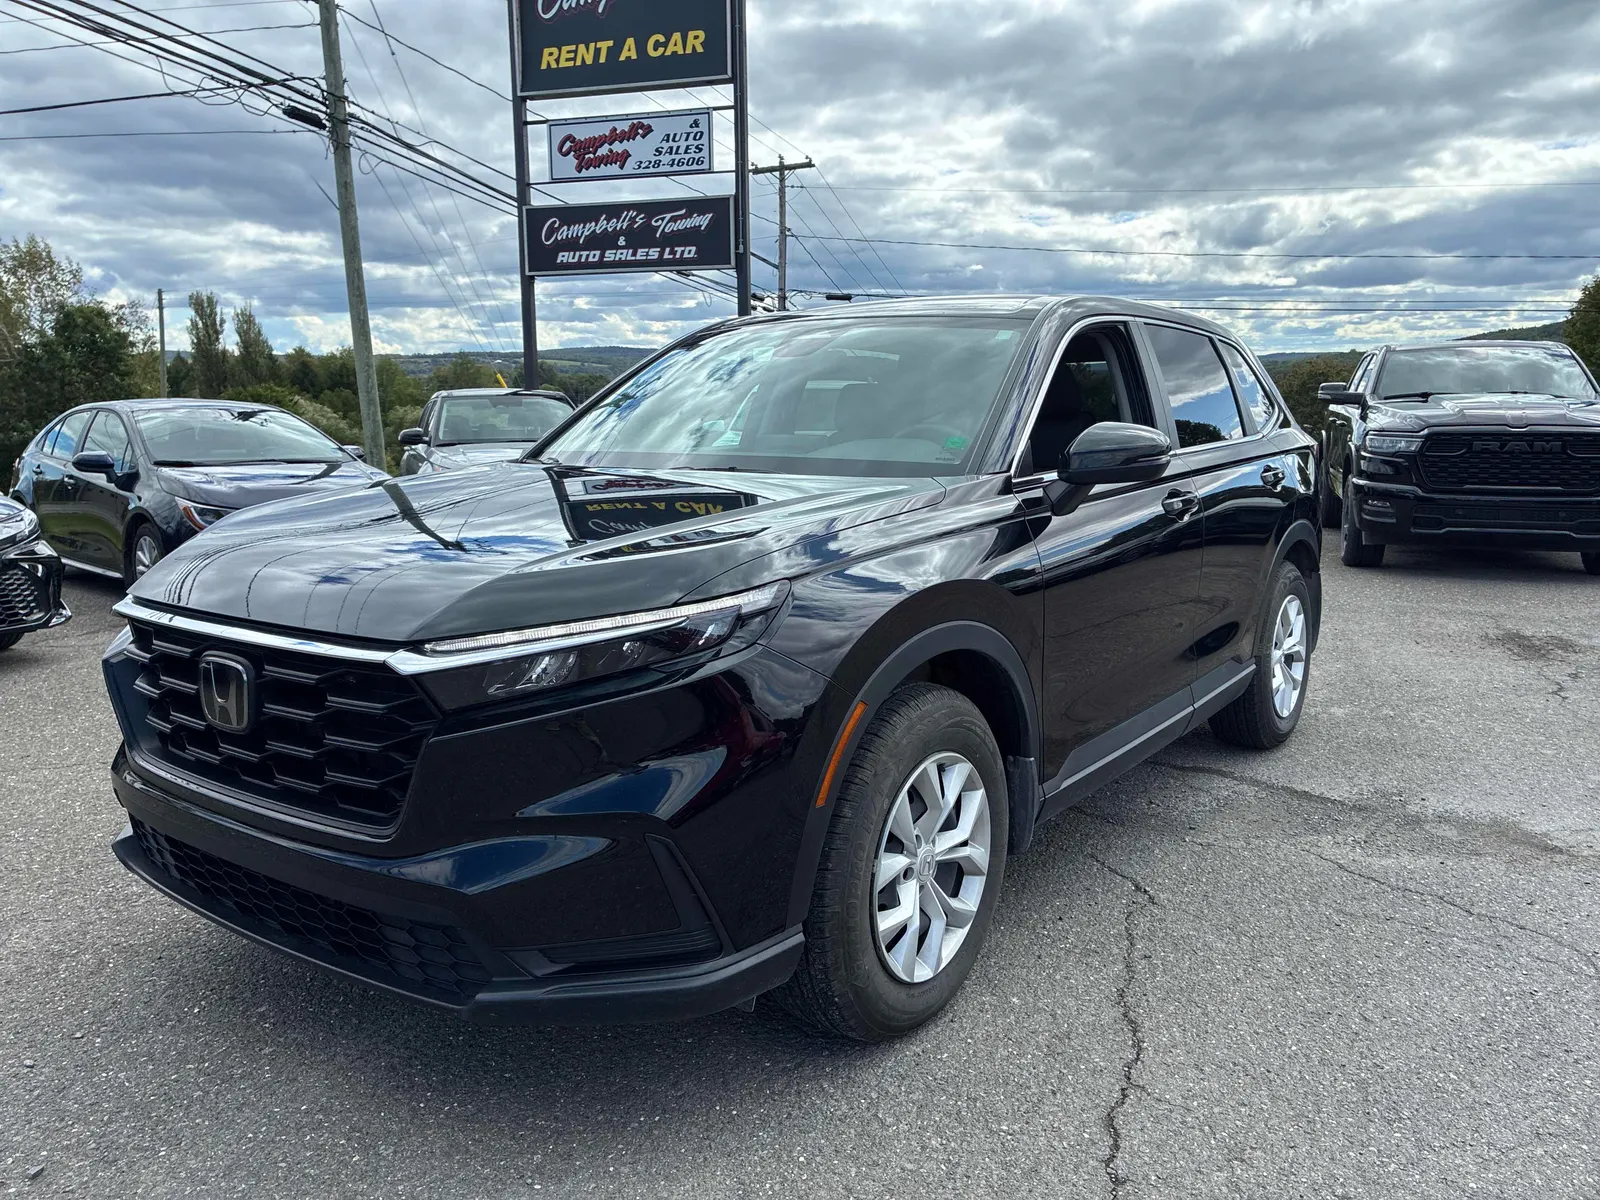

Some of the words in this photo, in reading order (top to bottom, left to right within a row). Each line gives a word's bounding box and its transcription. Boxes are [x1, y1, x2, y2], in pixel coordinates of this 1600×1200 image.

[540, 40, 614, 70] RENT
[619, 37, 638, 62] A
[646, 29, 706, 57] CAR
[689, 118, 701, 129] &
[557, 120, 654, 158] Campbell's
[659, 131, 704, 144] AUTO
[653, 144, 704, 157] SALES
[574, 148, 632, 174] Towing
[632, 156, 705, 171] 328-4606
[542, 210, 647, 246] Campbell's
[651, 208, 715, 239] Towing
[617, 236, 626, 246] &
[556, 250, 600, 264] AUTO
[603, 247, 660, 261] SALES
[663, 246, 698, 259] LTD.
[1472, 441, 1562, 452] RAM
